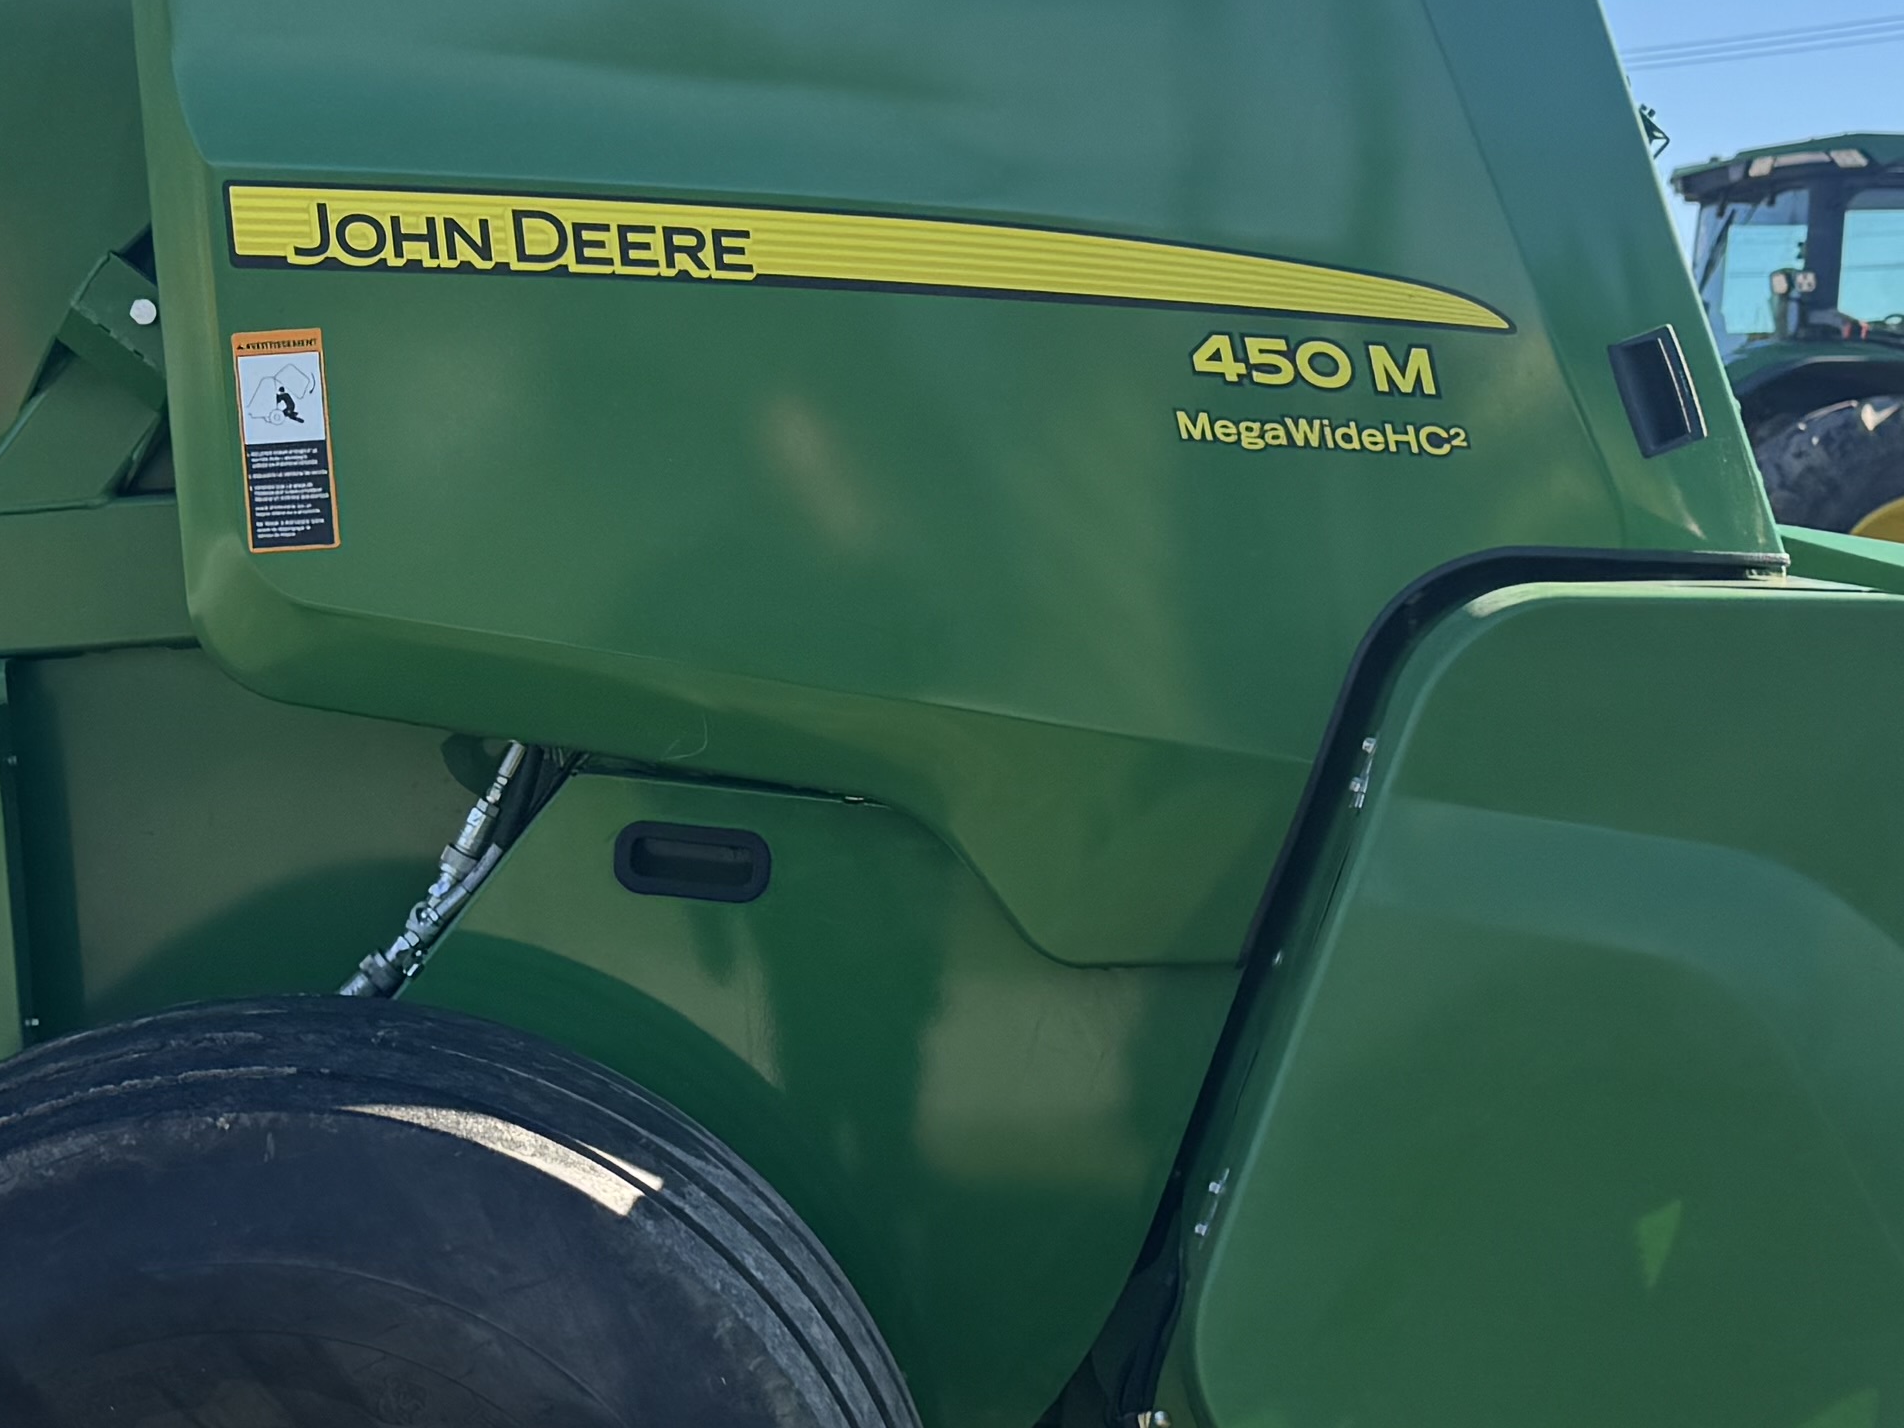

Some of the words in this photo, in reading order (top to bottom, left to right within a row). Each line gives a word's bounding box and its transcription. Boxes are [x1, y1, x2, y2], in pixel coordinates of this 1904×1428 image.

[293, 202, 493, 262] JOHN
[511, 209, 754, 273] DEERE
[1191, 334, 1353, 389] 450
[1368, 344, 1437, 395] M
